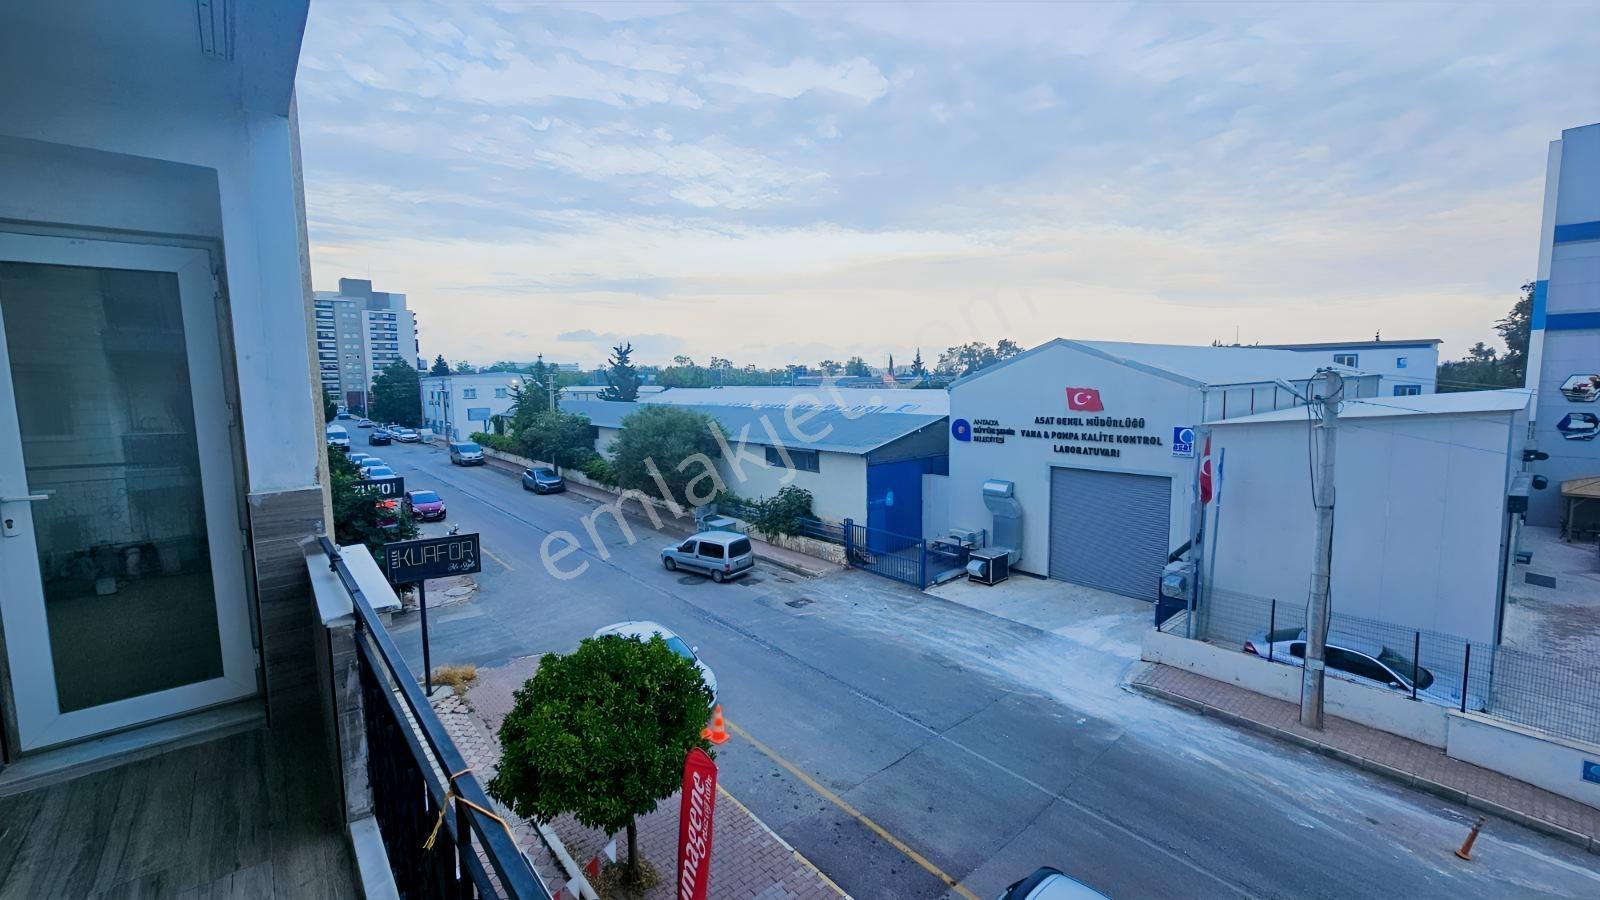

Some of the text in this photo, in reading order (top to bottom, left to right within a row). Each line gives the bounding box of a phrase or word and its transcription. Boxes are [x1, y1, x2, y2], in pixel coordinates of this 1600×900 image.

[1034, 416, 1055, 425] ASAT
[1056, 417, 1084, 426] GENEL
[1043, 431, 1050, 439] &
[1051, 431, 1079, 441] POMPA
[1081, 431, 1114, 443] KALİTE
[1116, 434, 1163, 446] KONTROL
[1053, 444, 1120, 458] LABORATUVARI
[397, 540, 474, 568] KUAFÖR
